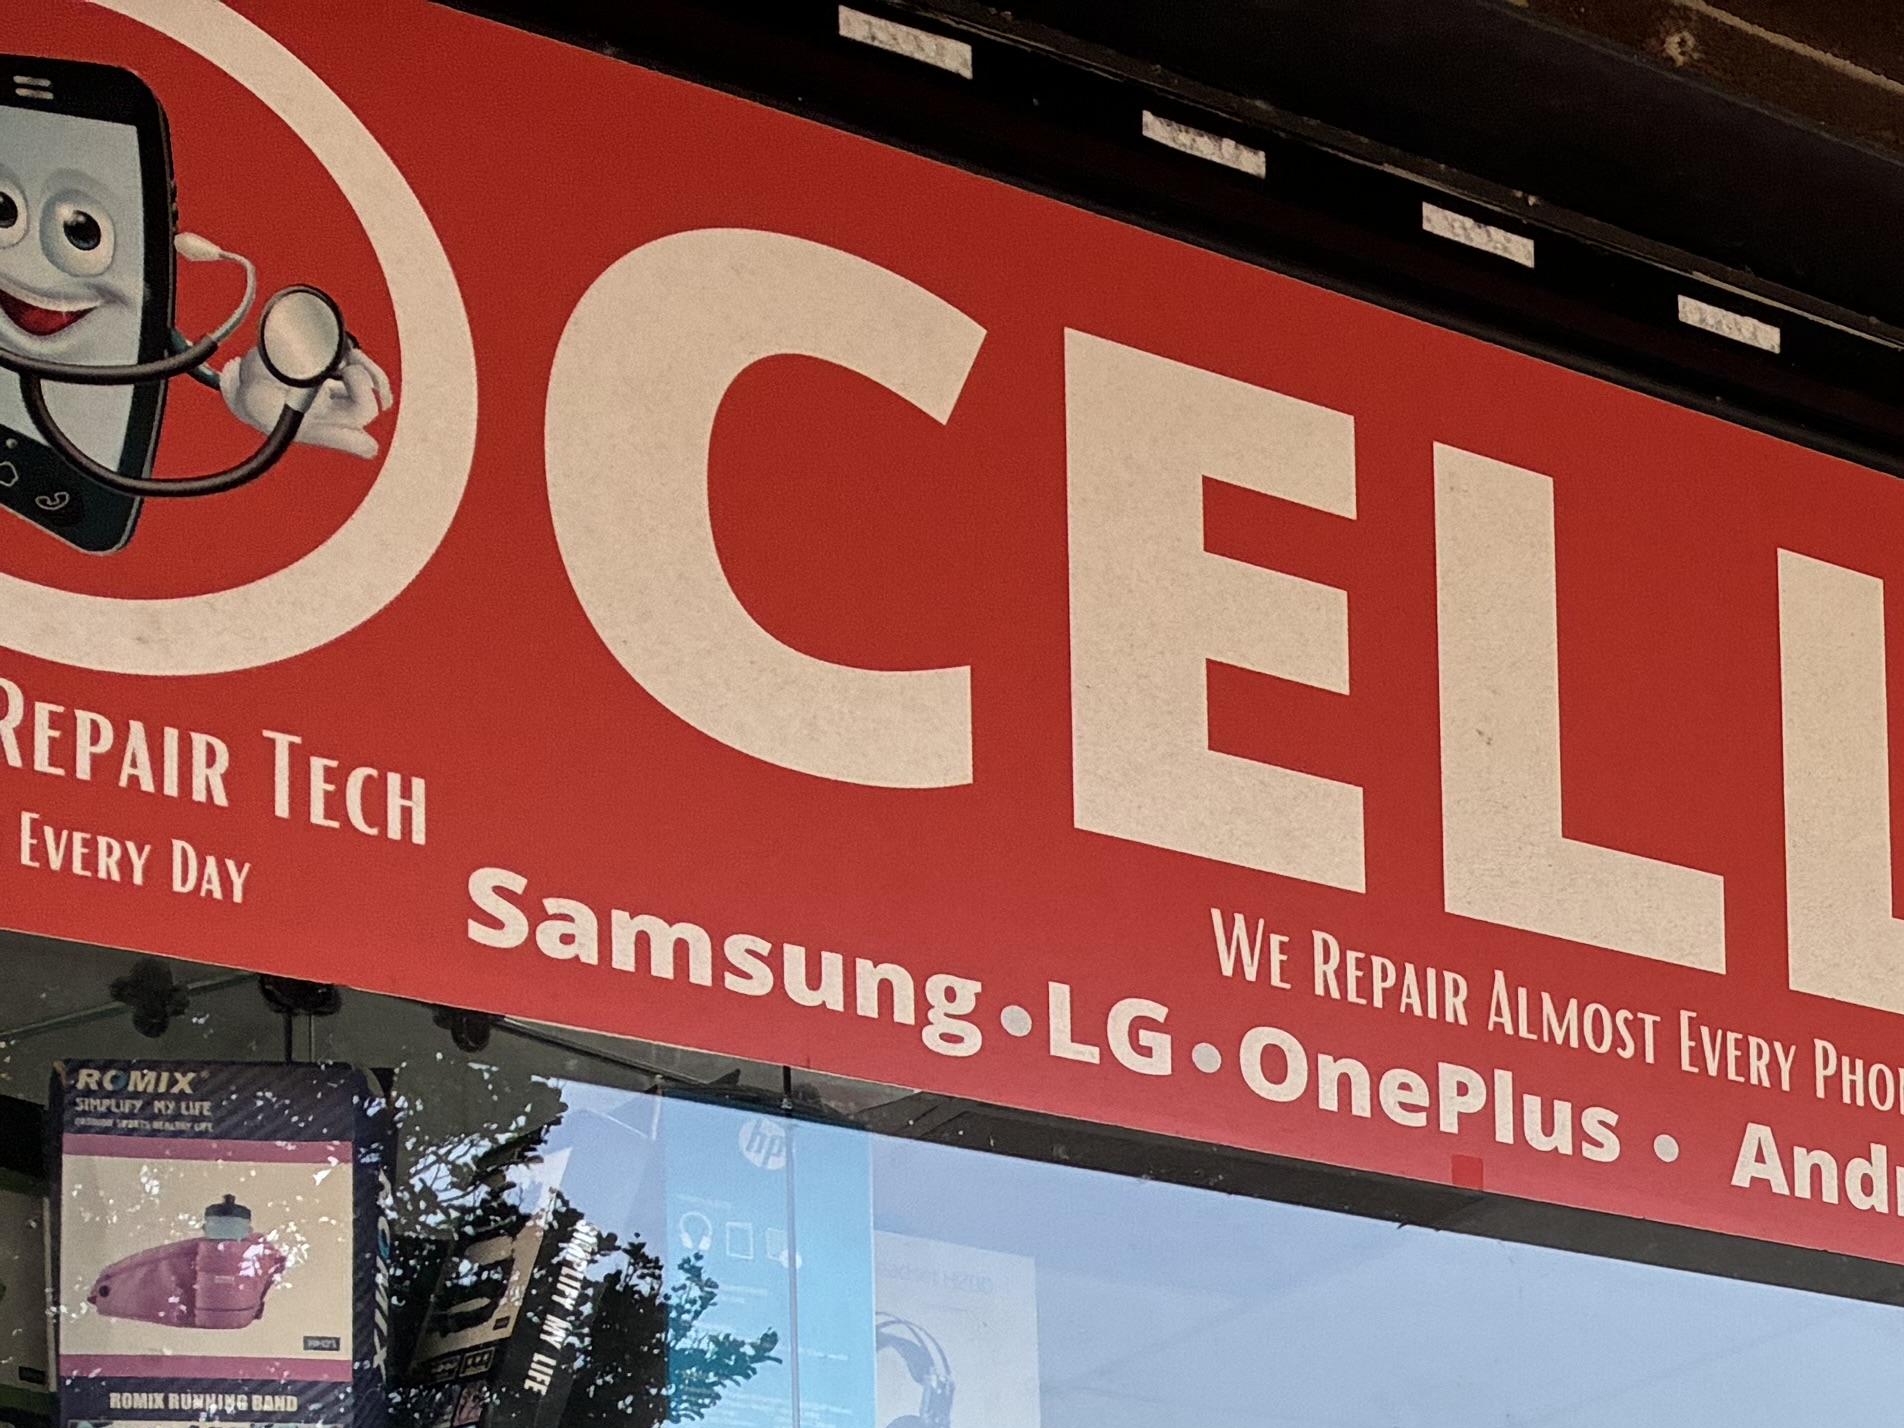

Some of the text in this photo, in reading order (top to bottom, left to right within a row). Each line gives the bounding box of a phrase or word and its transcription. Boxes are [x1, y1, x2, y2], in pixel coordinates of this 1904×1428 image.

[0, 679, 427, 845] REPAIR TECH
[19, 812, 252, 904] EVERY DAY
[467, 867, 983, 1057] Samsung
[1048, 981, 1173, 1076] LG
[1239, 1026, 1621, 1163] OnePlus
[1210, 908, 1291, 990] WE
[1312, 930, 1468, 1027] REPAIR
[1488, 969, 1661, 1065] ALMOST
[1680, 1011, 1796, 1093] EVERY
[75, 1068, 198, 1095] ROMIX
[74, 1097, 144, 1114] SIMPLIFY
[180, 1101, 212, 1117] LIFE
[745, 1118, 787, 1168] hp
[523, 1353, 558, 1396] LIFE
[109, 1392, 298, 1413] ROMIX RUNNING BAND
